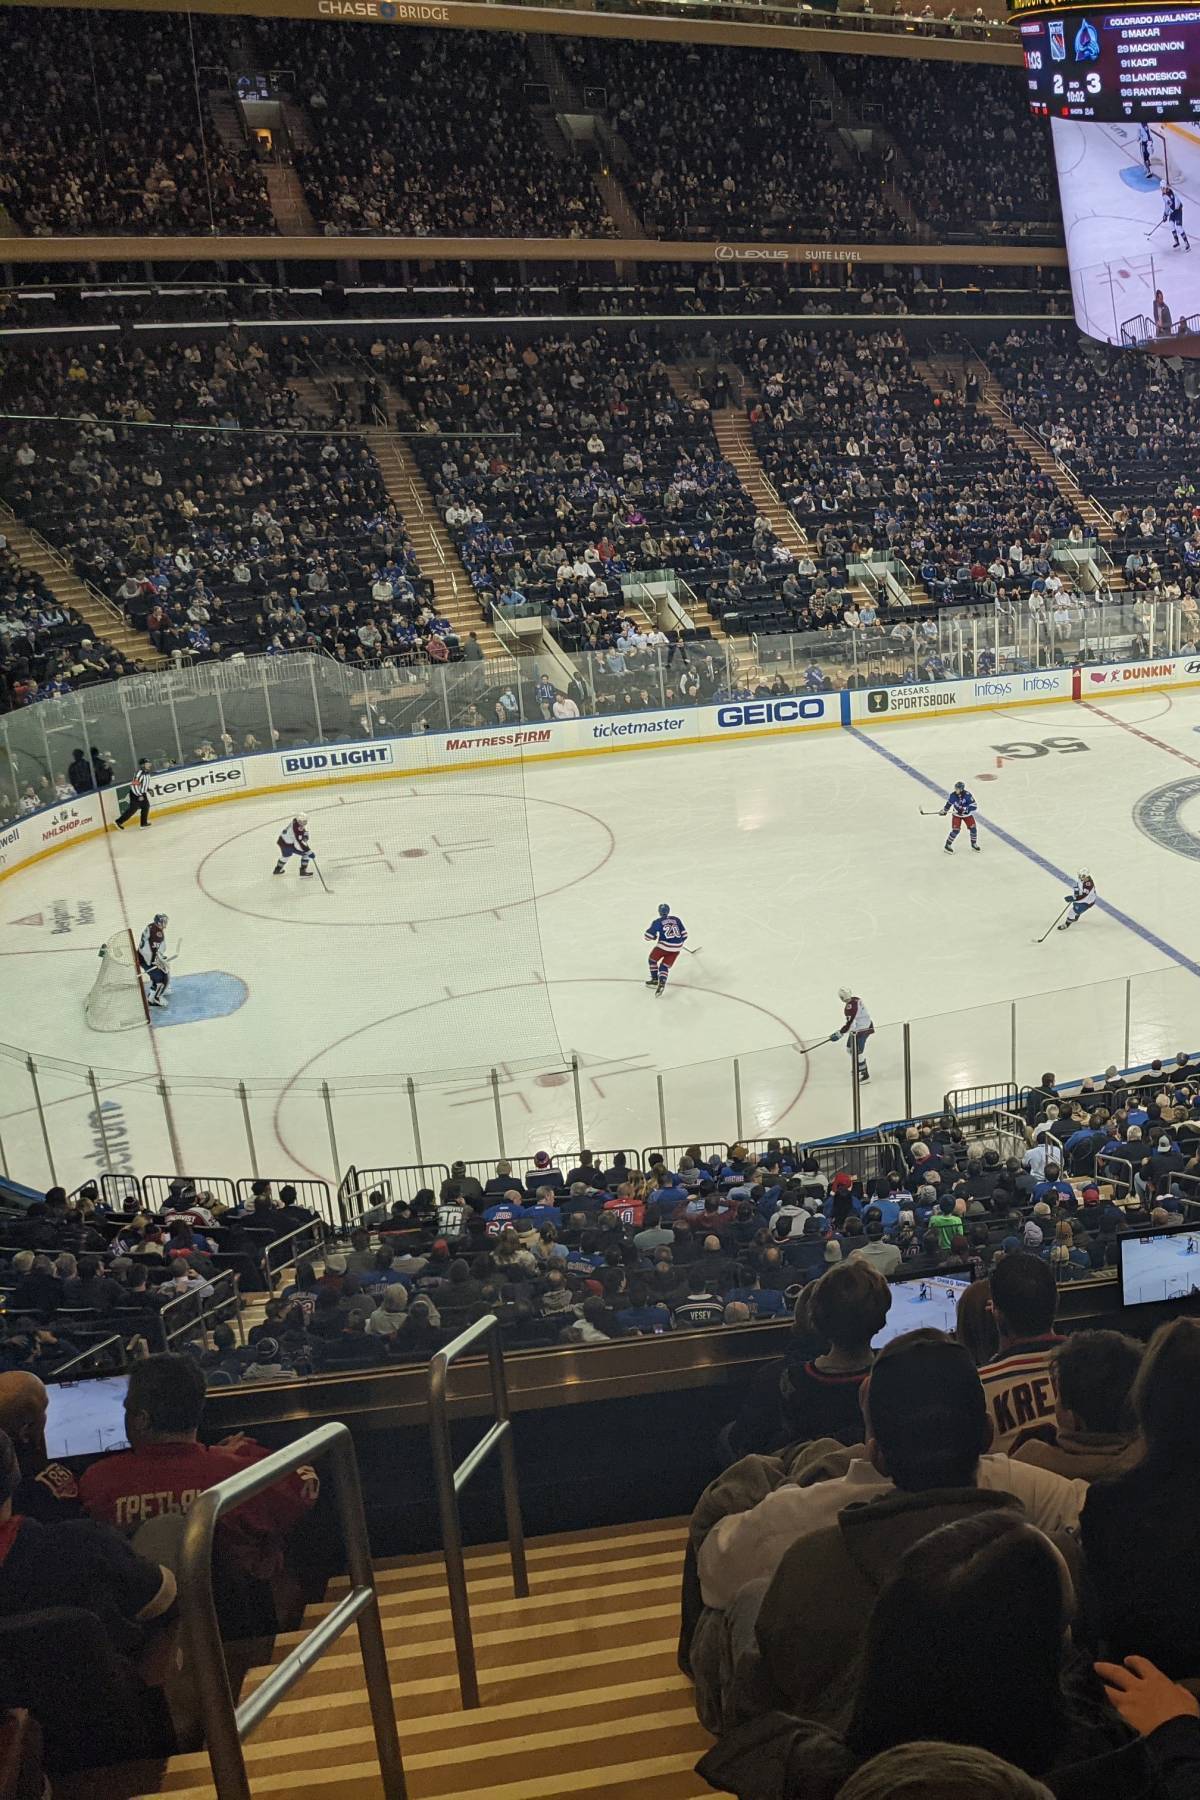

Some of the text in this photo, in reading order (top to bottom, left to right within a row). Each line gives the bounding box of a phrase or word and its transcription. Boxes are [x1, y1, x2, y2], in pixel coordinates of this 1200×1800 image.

[318, 1, 450, 21] CHASE BRIDGE
[1110, 16, 1153, 26] COLORADO
[1129, 28, 1160, 39] MAKAR
[1130, 41, 1184, 53] MACKINNON
[1131, 58, 1157, 68] KADRI
[1053, 74, 1065, 95] 2
[1086, 73, 1102, 94] 3
[1132, 71, 1187, 82] LANDESKOG
[1067, 91, 1085, 103] 10:02
[1134, 86, 1182, 97] RANTANEN
[735, 250, 862, 261] LEXUS SUITE LEVEL
[1123, 663, 1176, 681] DUNKIN'
[891, 686, 931, 697] CAESARS
[974, 680, 1012, 697] Infosys
[1023, 675, 1060, 692] Infosys
[891, 692, 957, 711] SPORTSBOOK
[717, 698, 825, 728] GEICO
[592, 718, 685, 738] ticketmaster
[991, 735, 1091, 761] 5G
[286, 747, 388, 773] BUD LIGHT
[41, 816, 93, 842] NHLSHOP.com
[690, 1311, 712, 1320] VESEY
[993, 1376, 1057, 1435] KRE
